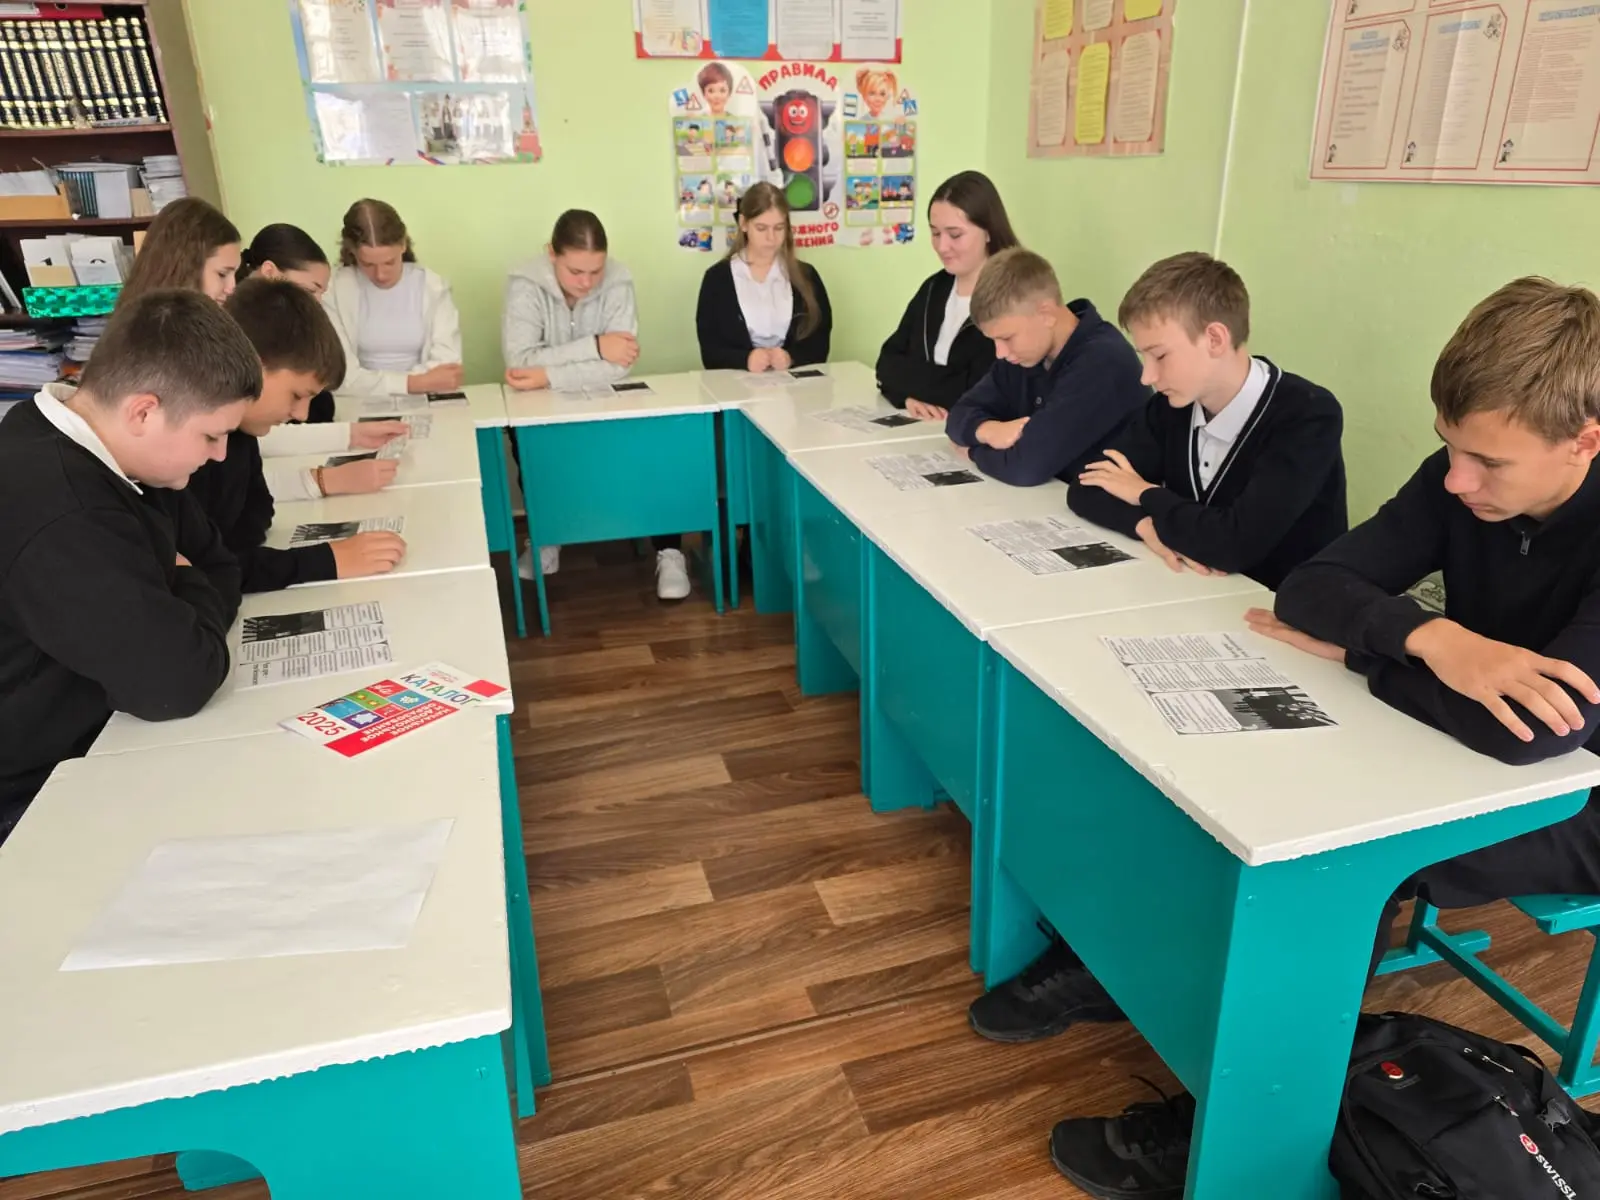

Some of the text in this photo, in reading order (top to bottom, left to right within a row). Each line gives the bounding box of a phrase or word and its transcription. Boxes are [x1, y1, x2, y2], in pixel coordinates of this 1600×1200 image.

[758, 62, 838, 92] ПРАВИЛА
[791, 221, 839, 234] ОЖНОГО
[400, 673, 481, 706] КАТАЛОГ
[297, 711, 347, 736] 2025
